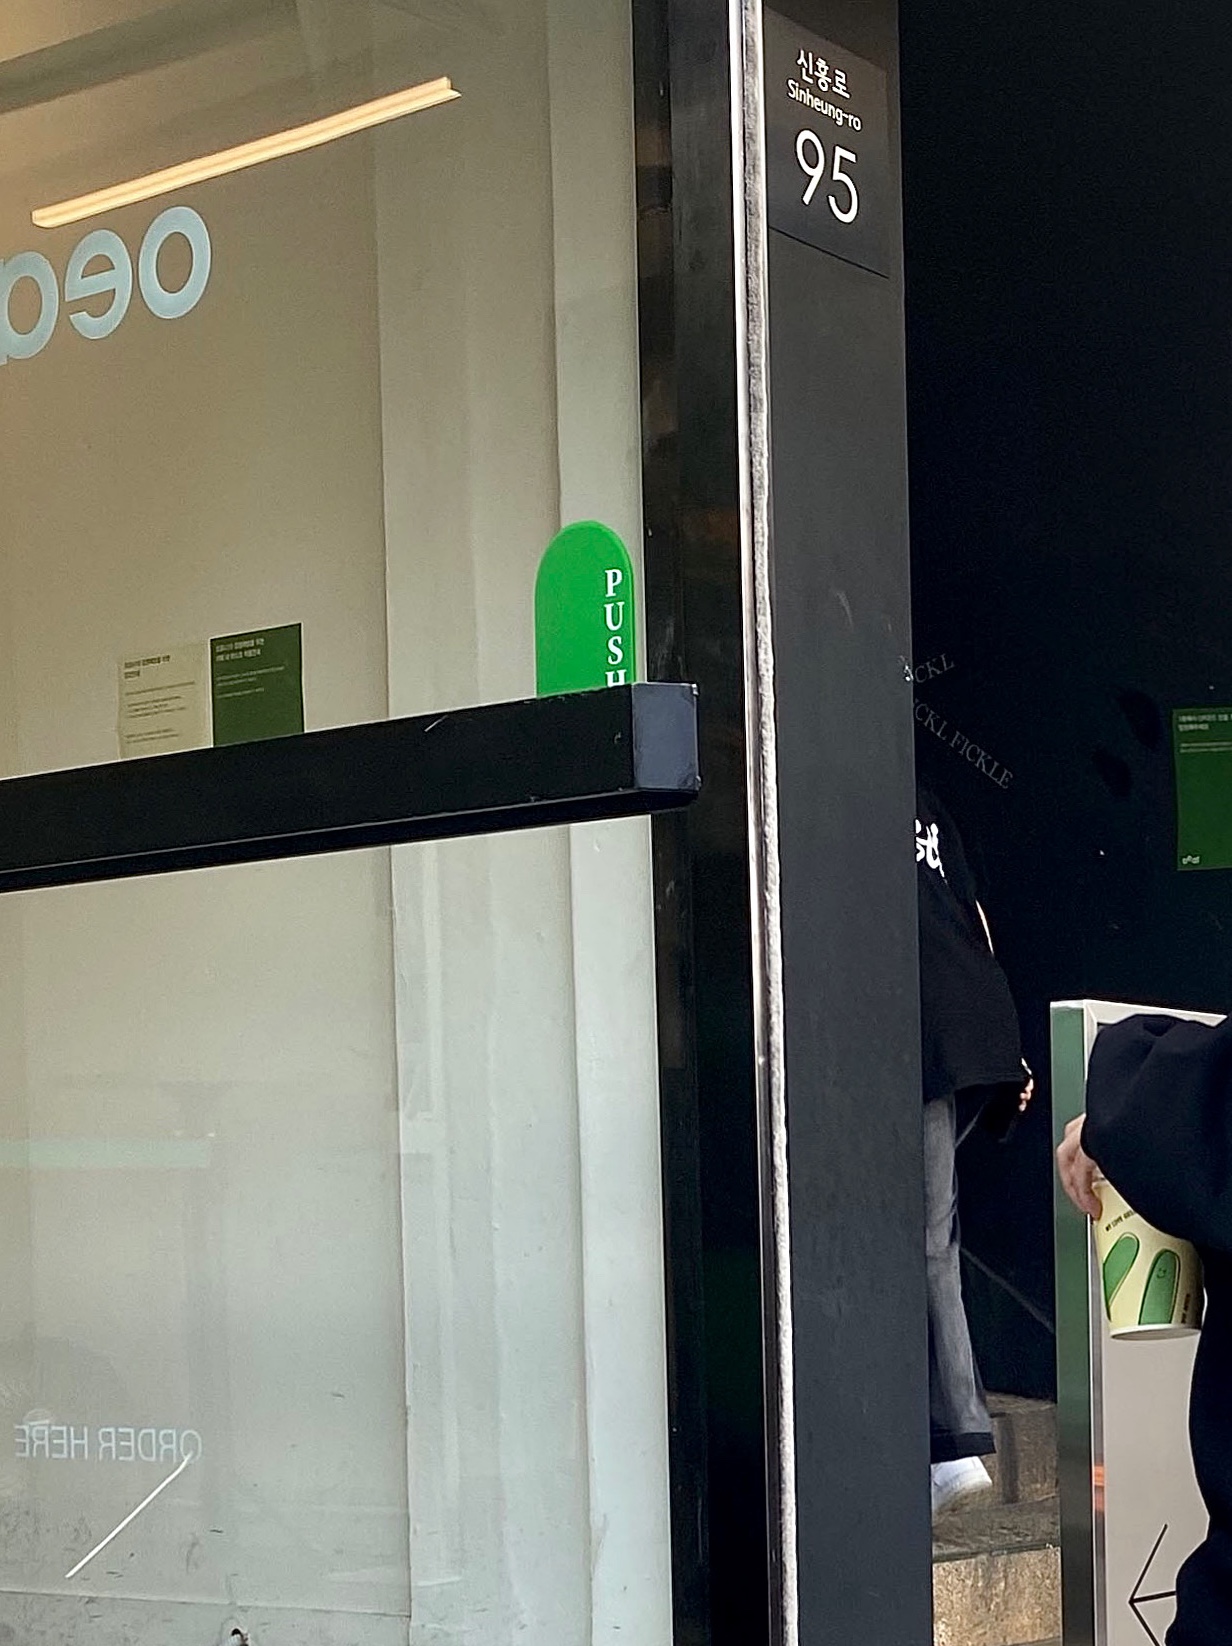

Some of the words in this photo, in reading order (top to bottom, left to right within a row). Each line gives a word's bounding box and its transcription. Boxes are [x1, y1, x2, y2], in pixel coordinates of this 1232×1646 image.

[787, 79, 863, 132] Sinheung-ro
[796, 49, 851, 99] 신흥로
[795, 129, 859, 224] 95
[603, 568, 627, 688] PUSH
[914, 653, 955, 684] CKL
[914, 698, 948, 741] CKL
[949, 730, 1014, 790] FICKLE
